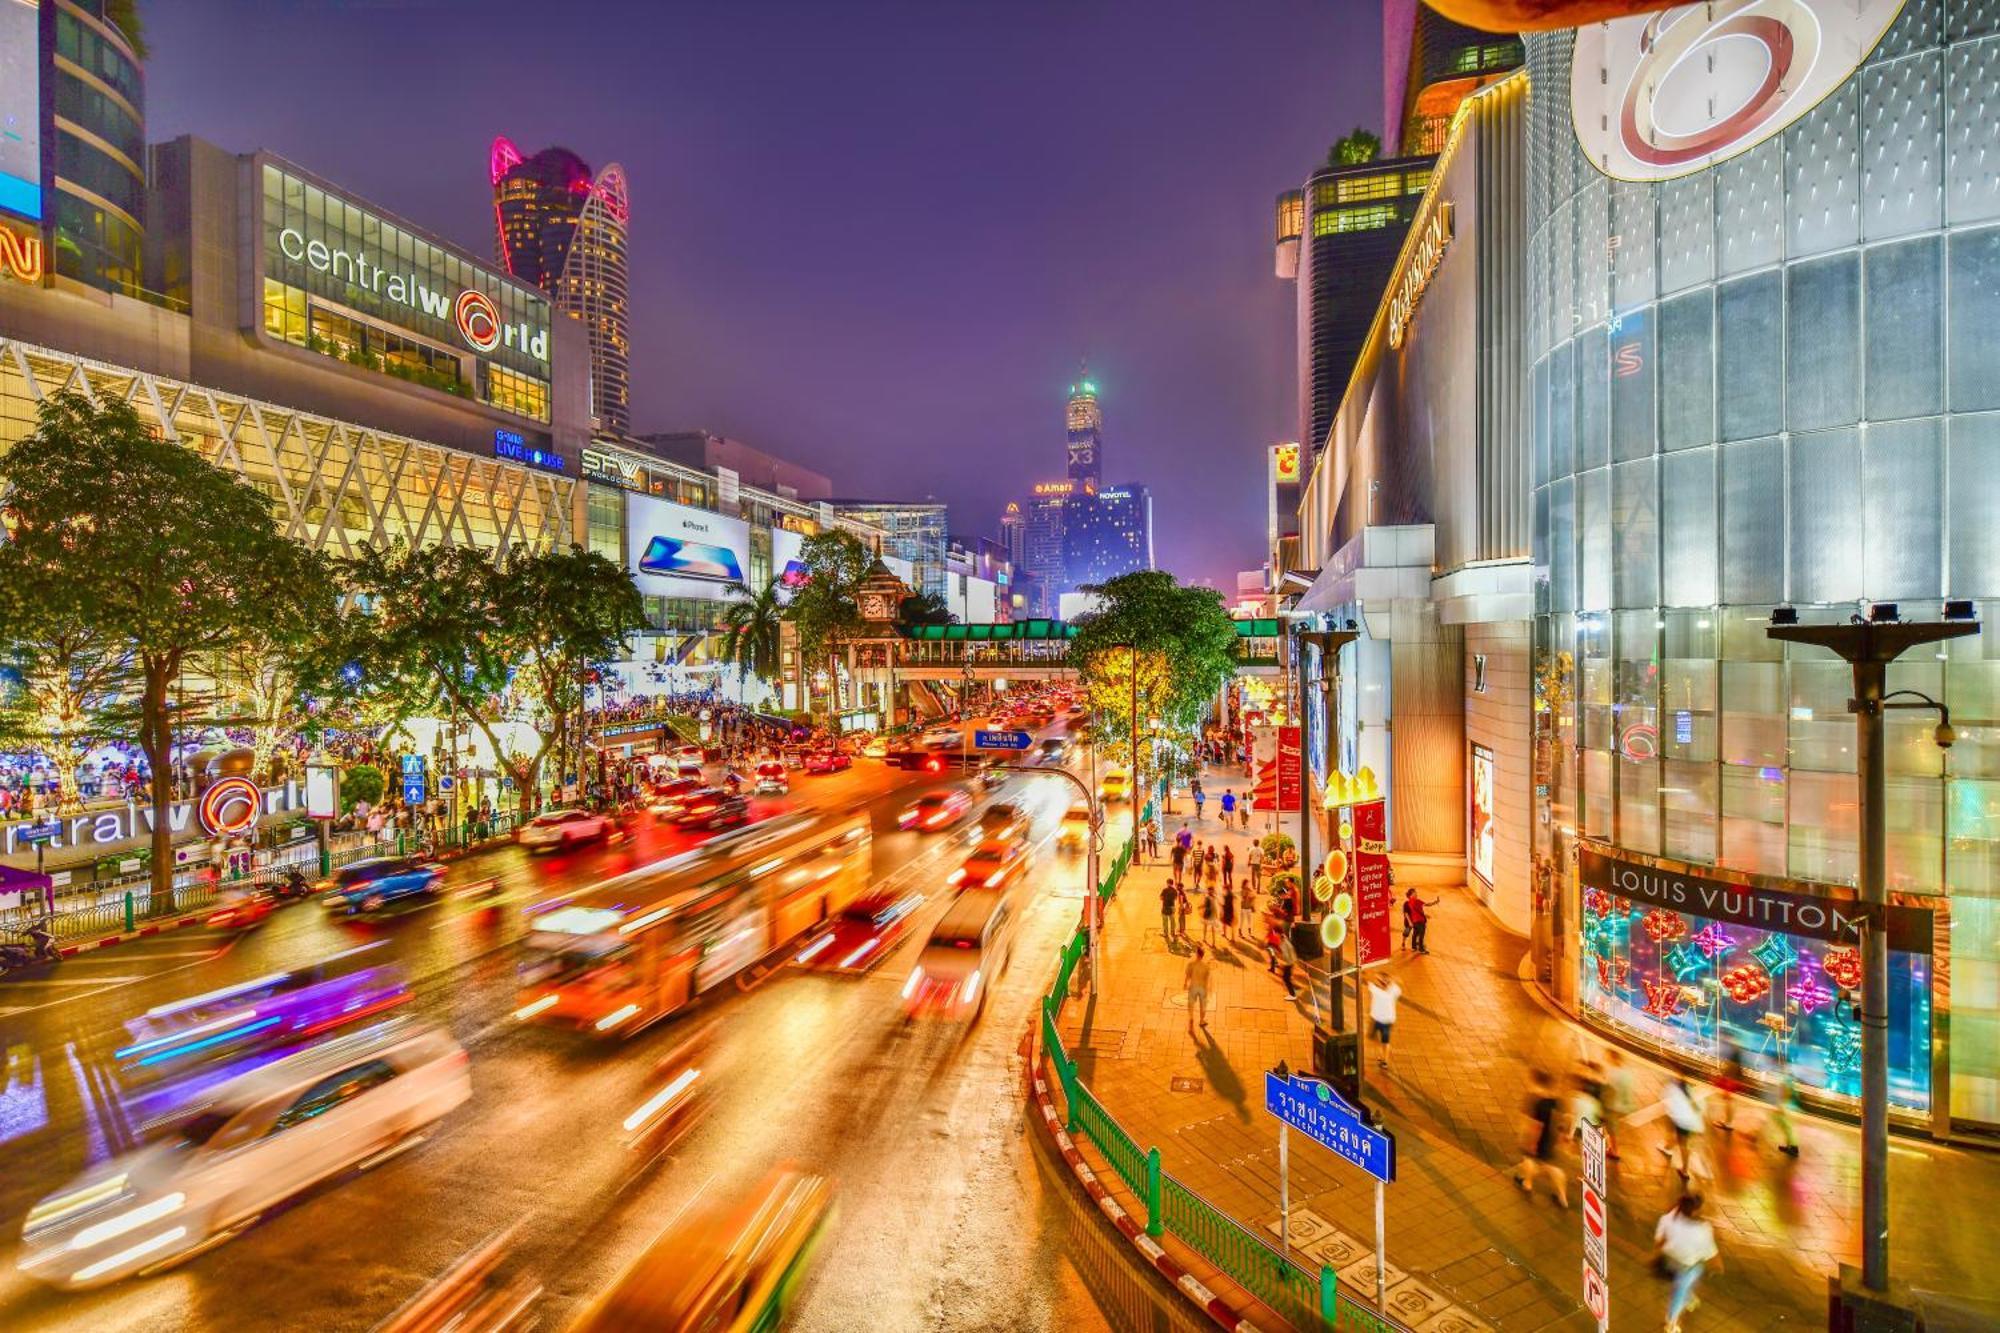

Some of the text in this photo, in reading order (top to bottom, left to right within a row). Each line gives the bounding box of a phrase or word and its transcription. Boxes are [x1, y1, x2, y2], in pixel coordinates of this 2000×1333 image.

[496, 443, 522, 458] LIVE
[1100, 491, 1131, 500] NOVOTEL
[1612, 867, 1858, 935] LOUIS VUITTON
[1279, 1091, 1372, 1157] ราชประสงค์
[1283, 1109, 1365, 1167] Ratchaprasong
